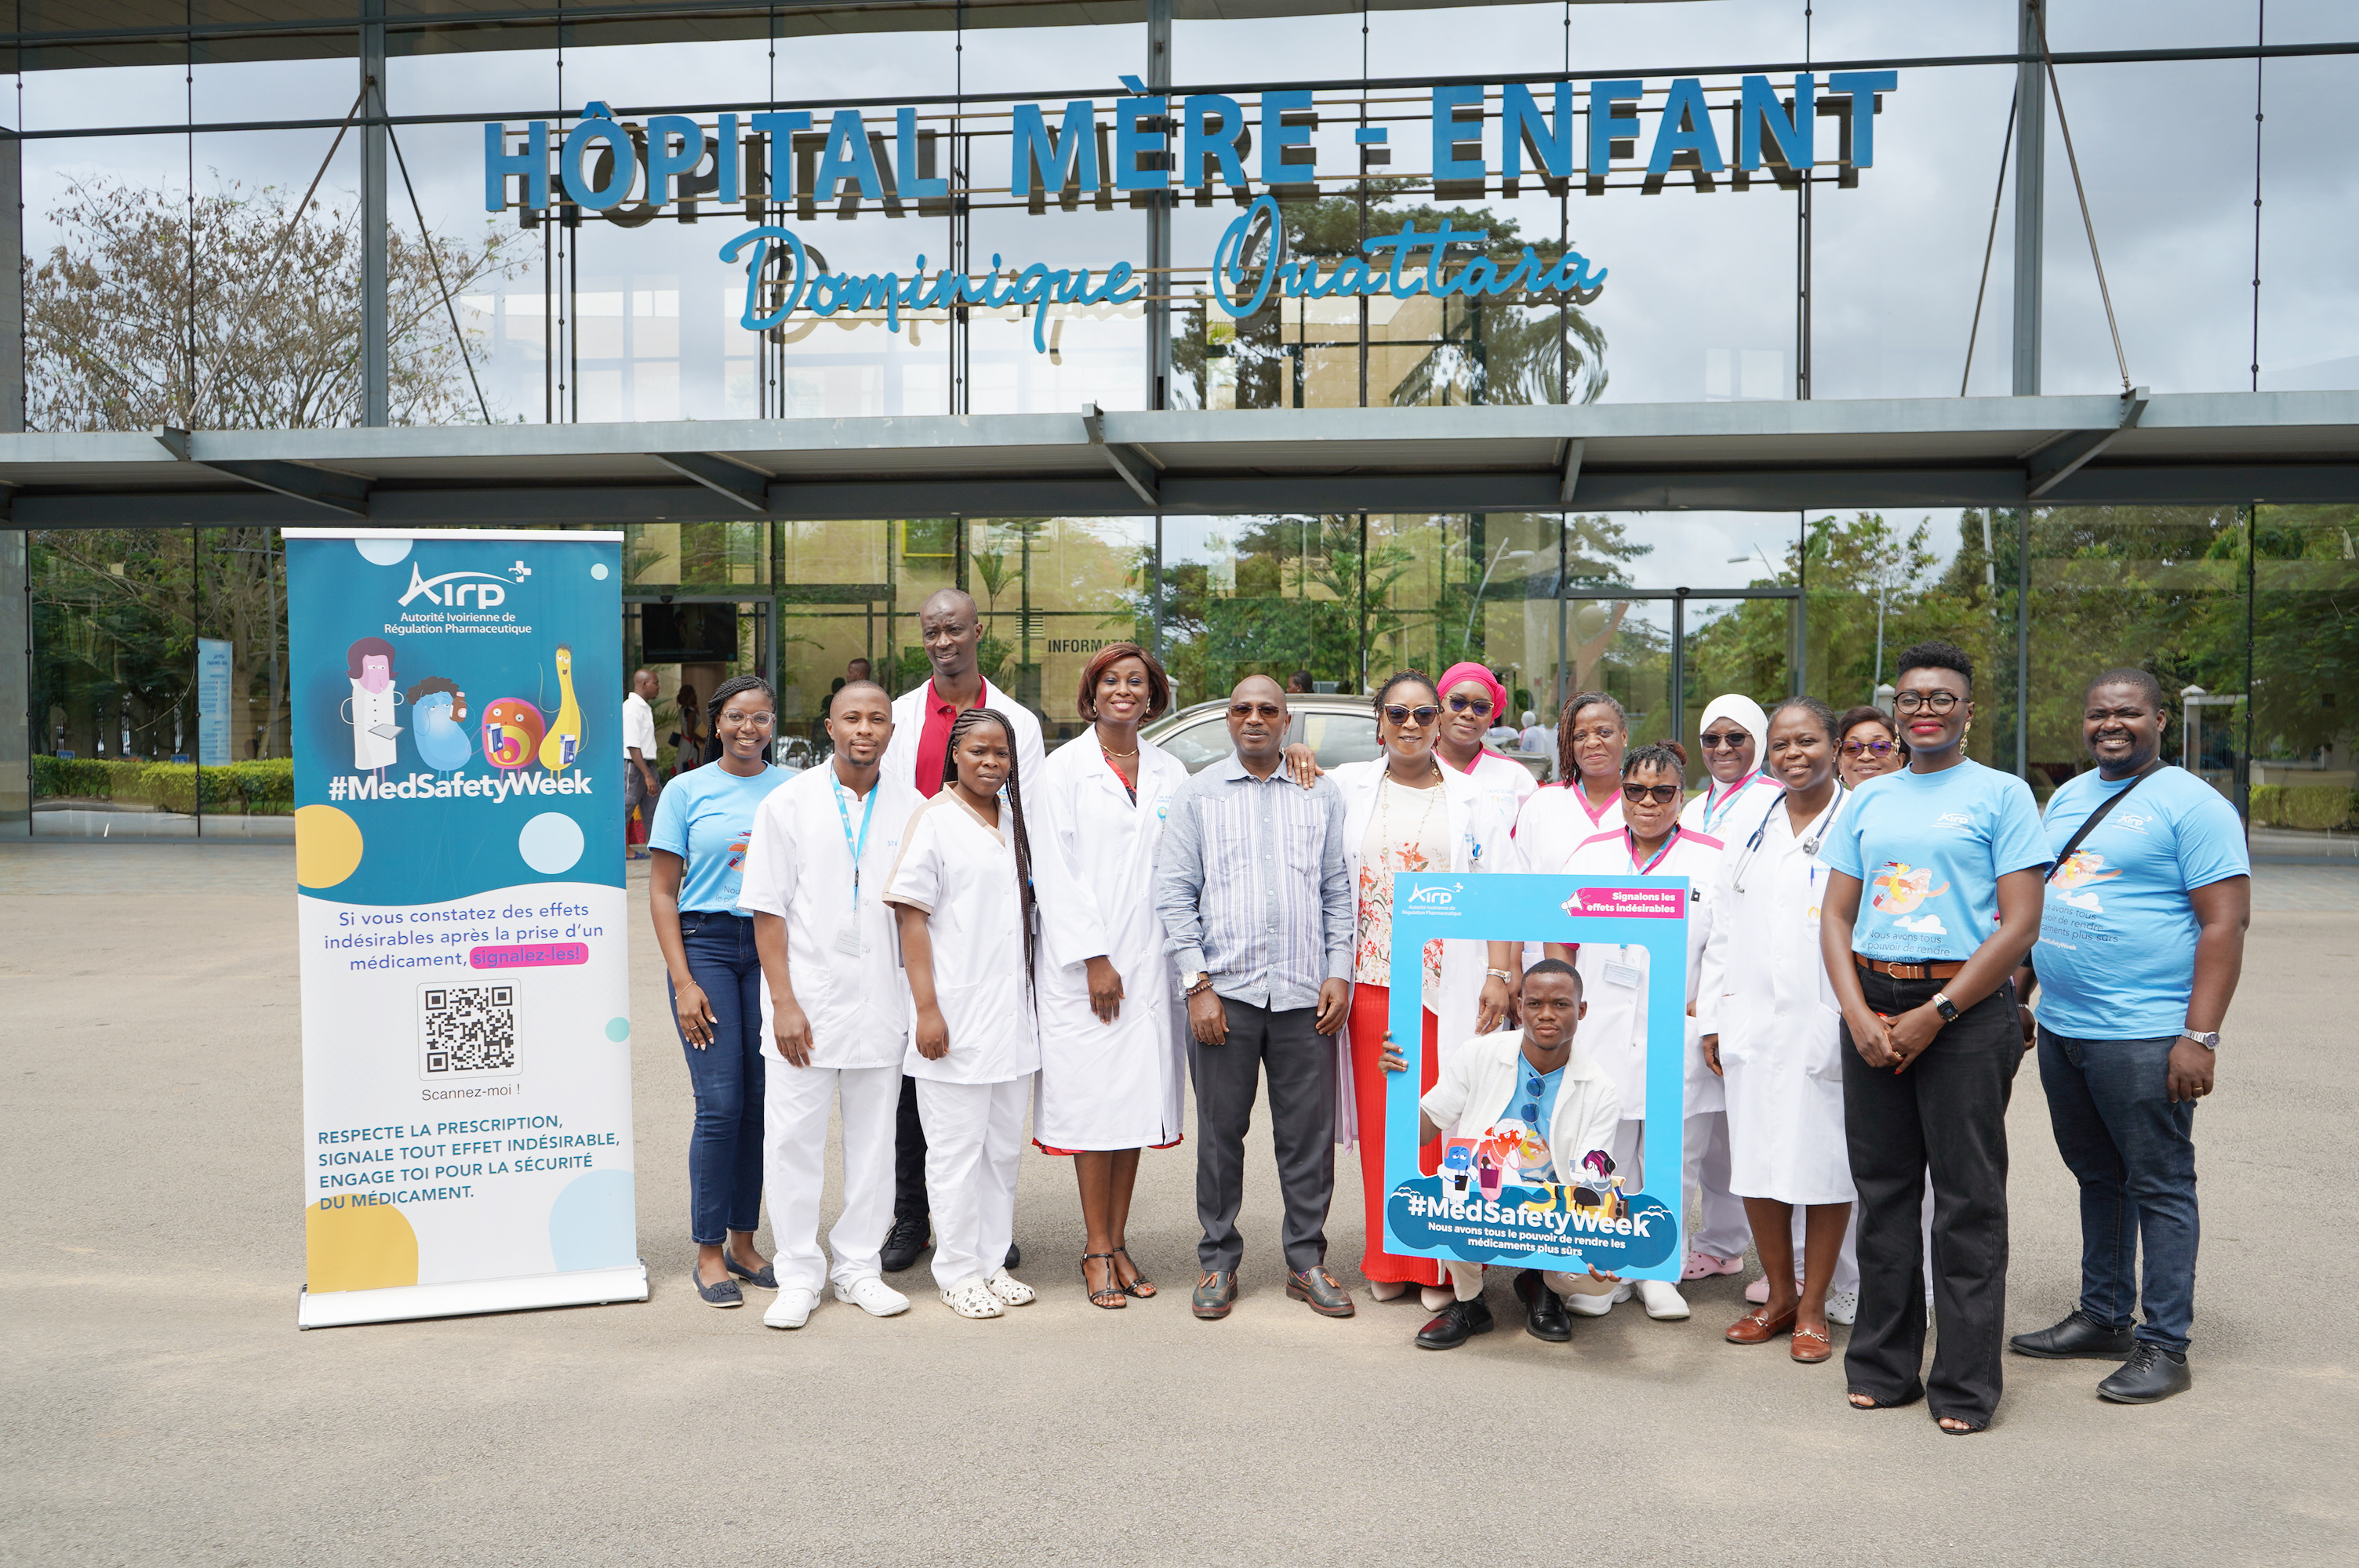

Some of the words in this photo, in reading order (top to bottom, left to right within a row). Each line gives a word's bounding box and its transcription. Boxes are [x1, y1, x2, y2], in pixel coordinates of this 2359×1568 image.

[485, 101, 948, 212] HÔPITAL
[1012, 74, 1314, 198] MÈRE
[1433, 70, 1898, 183] ENFANT
[719, 226, 1143, 354] Dominique
[1212, 194, 1608, 319] Ouattara
[400, 612, 445, 622] Autorité
[447, 612, 500, 622] Ivoirienne
[502, 612, 516, 622] de
[384, 623, 442, 636] Régulation
[445, 623, 533, 636] Pharmaceutique
[1048, 639, 1139, 653] INFORM
[328, 769, 593, 804] #MedSafetyWeek
[723, 885, 740, 895] Nou
[1612, 891, 1660, 902] Signalons
[1661, 892, 1676, 902] les
[339, 912, 355, 927] Si
[362, 913, 403, 925] vous
[409, 908, 496, 924] constatez
[502, 904, 533, 919] des
[539, 902, 589, 917] effets
[1587, 902, 1615, 912] effets
[1616, 902, 1676, 913] indésirables
[2052, 905, 2074, 915] avons
[2076, 909, 2097, 920] tous
[2041, 914, 2057, 923] uvoir
[2058, 916, 2069, 925] de
[2070, 920, 2104, 931] rendre
[325, 930, 434, 949] indésirables
[441, 927, 489, 946] après
[496, 927, 510, 941] la
[517, 925, 558, 944] prise
[565, 923, 603, 938] d'un
[1892, 933, 1918, 942] avons
[1921, 935, 1942, 944] tous
[2041, 924, 2070, 937] caments
[2071, 930, 2093, 941] plus
[2096, 933, 2118, 942] sûrs
[350, 952, 468, 971] médicament,
[473, 946, 580, 967] signalez-les!
[1867, 942, 1901, 952] pouvoir
[1903, 943, 1915, 953] de
[1917, 946, 1950, 956] rendre
[422, 1084, 512, 1101] Scannez-moi
[516, 1084, 521, 1095] !
[318, 1126, 405, 1145] RESPECTE
[410, 1124, 431, 1138] LA
[437, 1115, 563, 1135] PRESCRIPTION,
[318, 1148, 394, 1167] SIGNALE
[399, 1145, 446, 1160] TOUT
[452, 1140, 502, 1156] EFFET
[508, 1133, 620, 1152] INDÉSIRABLE,
[319, 1170, 394, 1189] ENGAGE
[401, 1167, 429, 1181] TOI
[435, 1163, 483, 1179] POUR
[488, 1161, 510, 1174] LA
[514, 1152, 593, 1173] SÉCURITÉ
[320, 1196, 345, 1210] DU
[352, 1185, 474, 1208] MÉDICAMENT.
[1408, 1195, 1651, 1238] #MedSafetyWeek
[1427, 1221, 1452, 1232] Nous
[1454, 1225, 1483, 1236] avons
[1484, 1227, 1506, 1238] tous
[1507, 1229, 1518, 1239] le
[1518, 1232, 1558, 1241] pouvoir
[1559, 1234, 1572, 1244] de
[1574, 1236, 1609, 1248] rendre
[1611, 1239, 1627, 1249] les
[1467, 1237, 1536, 1252] médicaments
[1537, 1243, 1560, 1254] plus
[1561, 1245, 1583, 1256] sûrs
